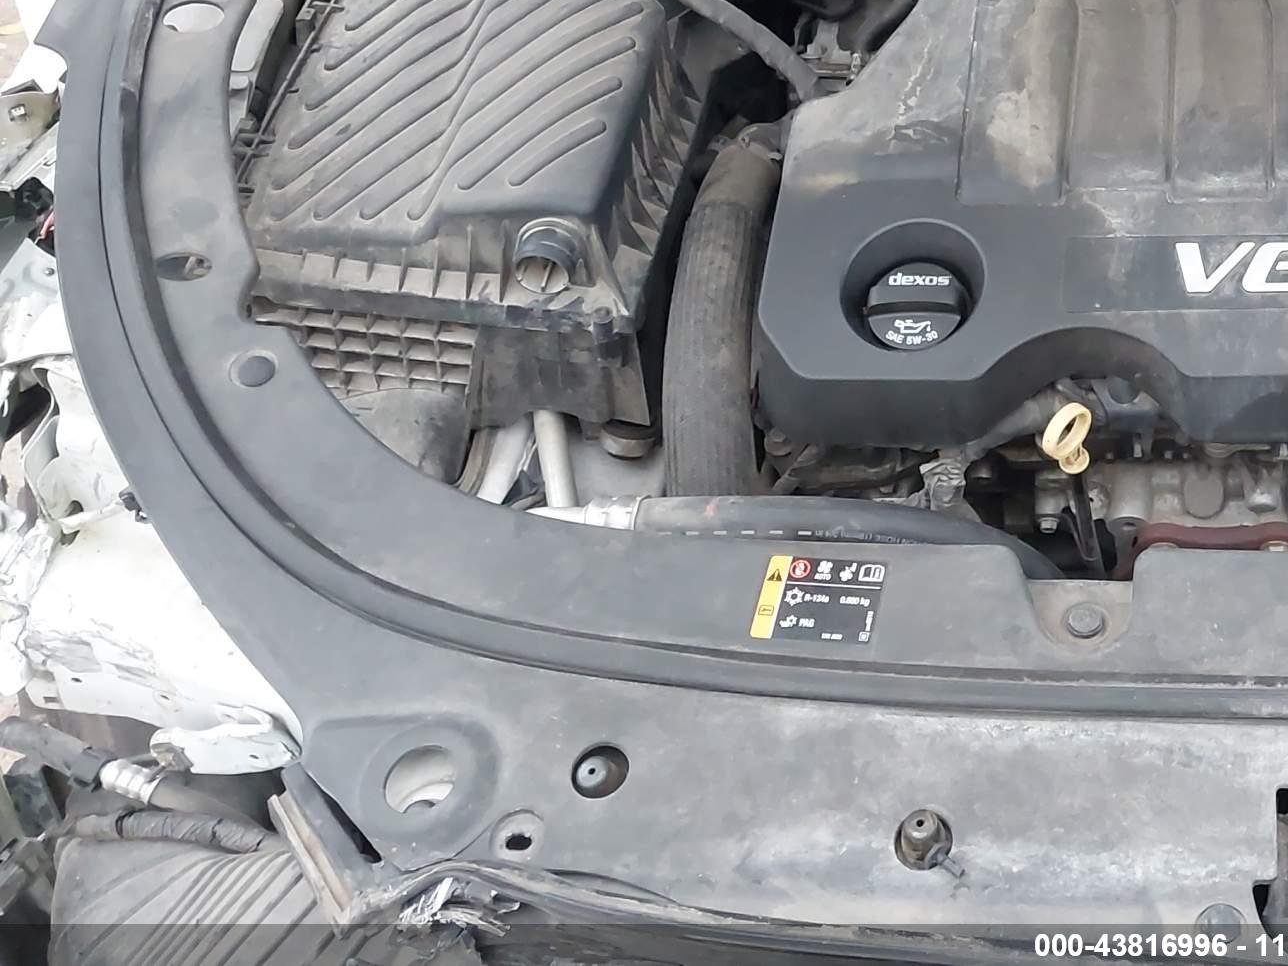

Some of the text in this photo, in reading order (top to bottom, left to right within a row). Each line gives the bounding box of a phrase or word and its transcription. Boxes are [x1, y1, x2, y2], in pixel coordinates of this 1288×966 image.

[888, 273, 951, 285] dexos
[885, 330, 938, 345] SAE 5W-30
[798, 618, 815, 627] PAG
